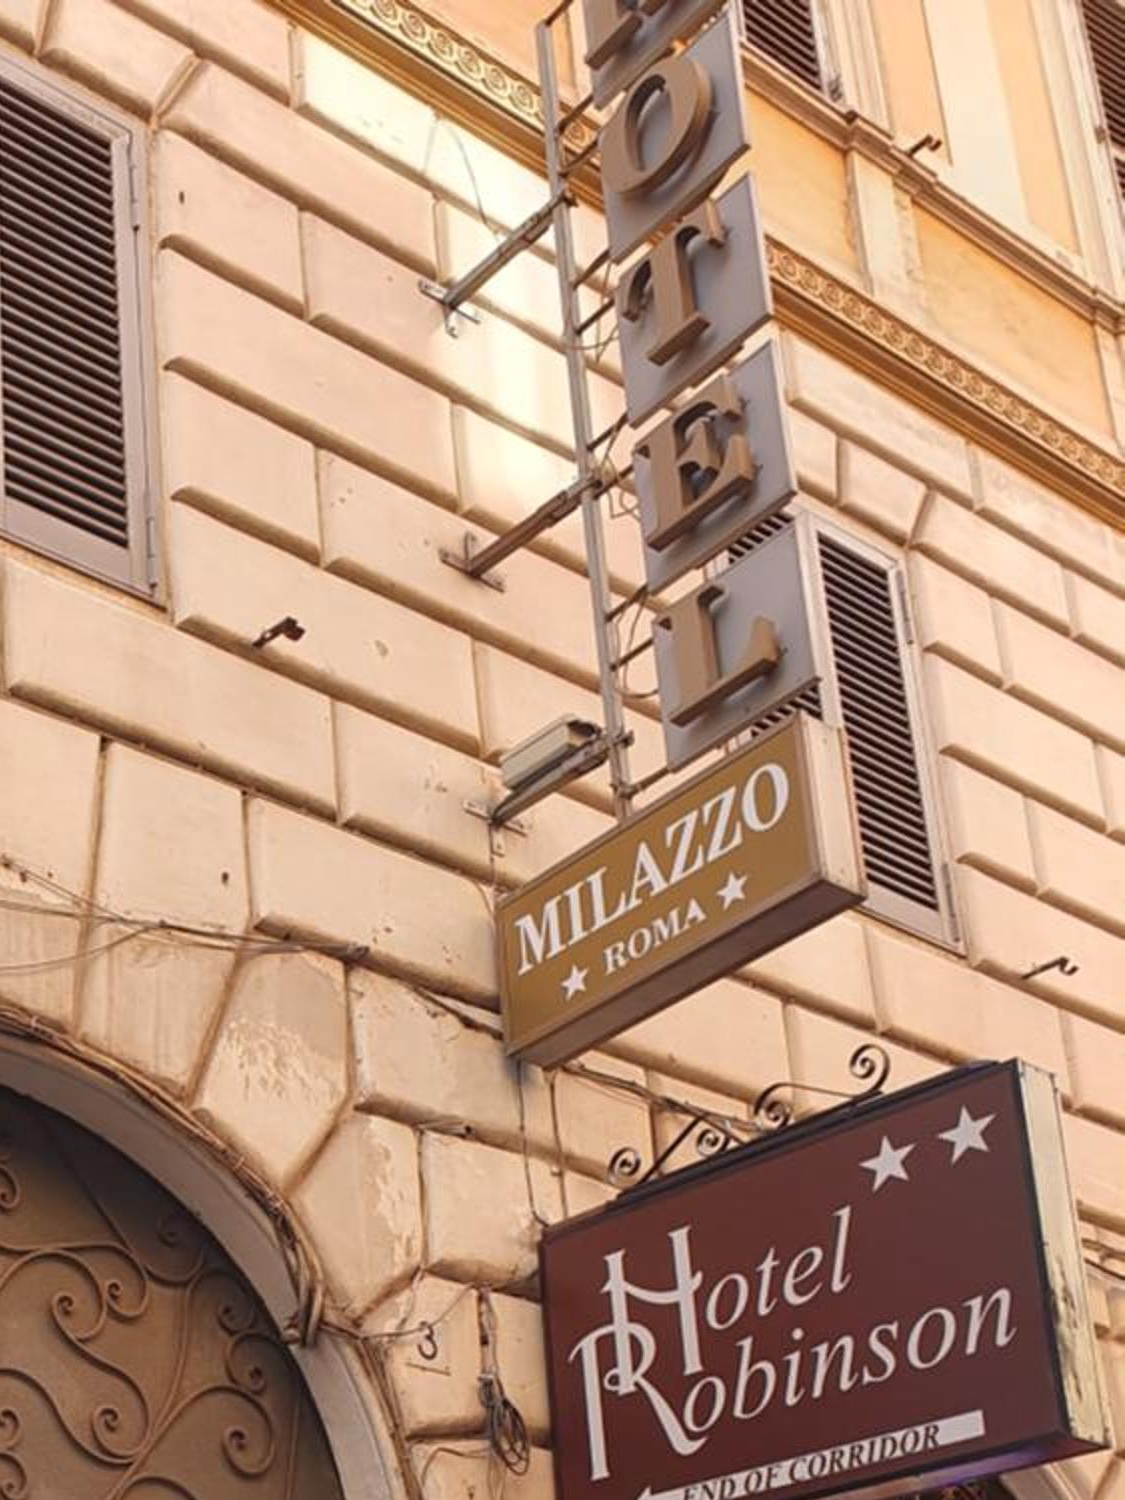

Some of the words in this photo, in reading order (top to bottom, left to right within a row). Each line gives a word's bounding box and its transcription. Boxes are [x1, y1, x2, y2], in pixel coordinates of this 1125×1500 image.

[515, 760, 791, 975] MILAZZO
[603, 898, 706, 976] ROMA
[568, 1287, 1018, 1480] Robinson
[602, 1204, 853, 1396] Hotel
[744, 1466, 779, 1495] OF
[788, 1424, 941, 1483] CORRIDOR
